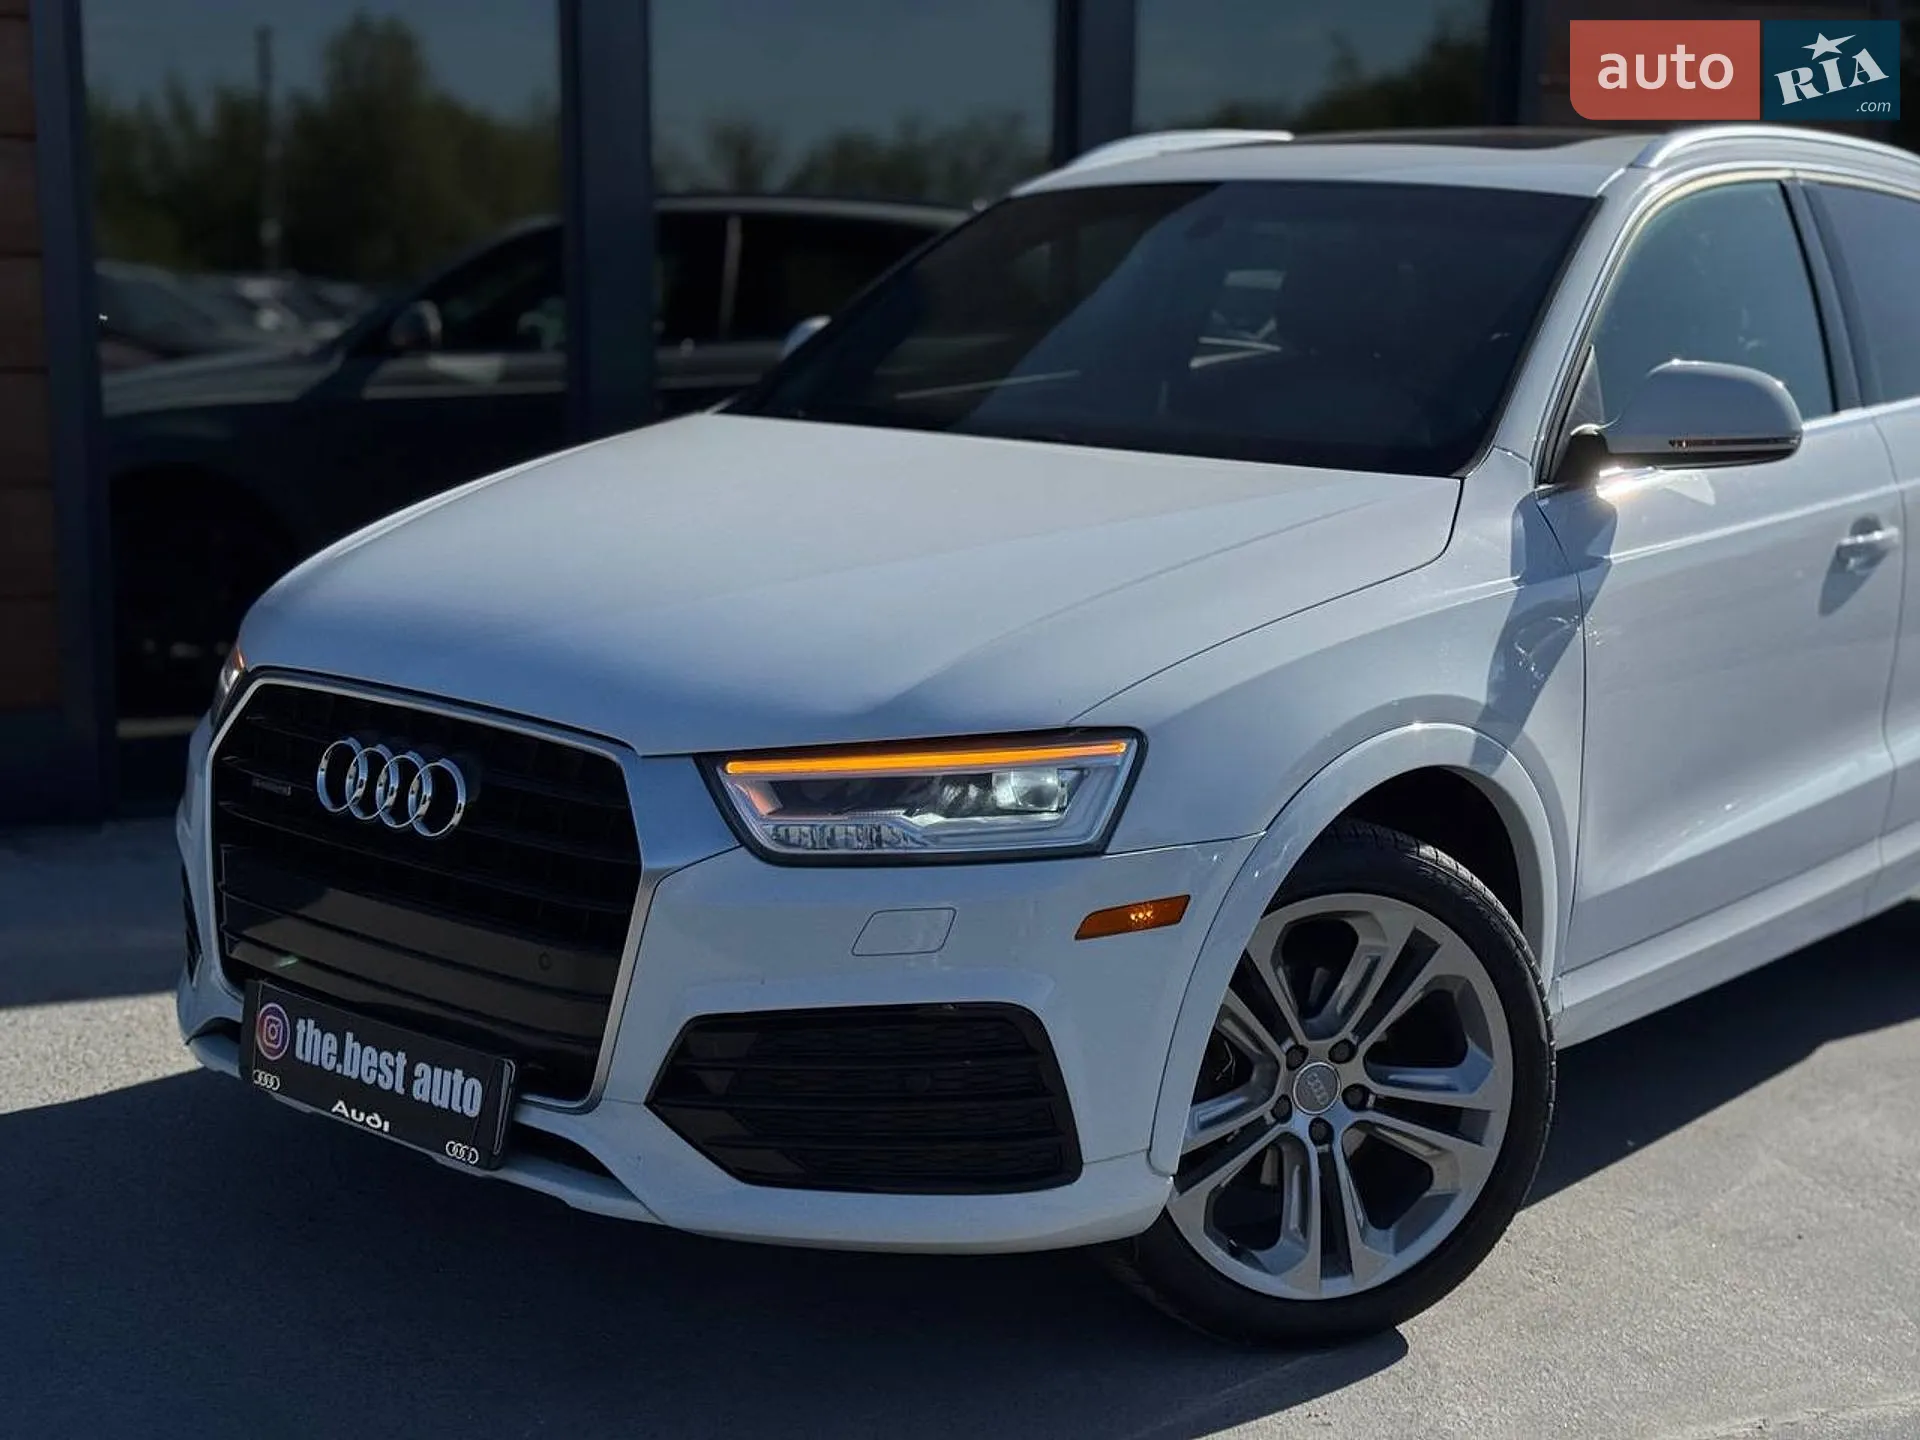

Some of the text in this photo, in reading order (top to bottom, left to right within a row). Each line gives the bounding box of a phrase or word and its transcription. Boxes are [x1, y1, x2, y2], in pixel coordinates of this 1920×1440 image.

[295, 1018, 483, 1118] the.best auto
[331, 1099, 390, 1133] Audi
